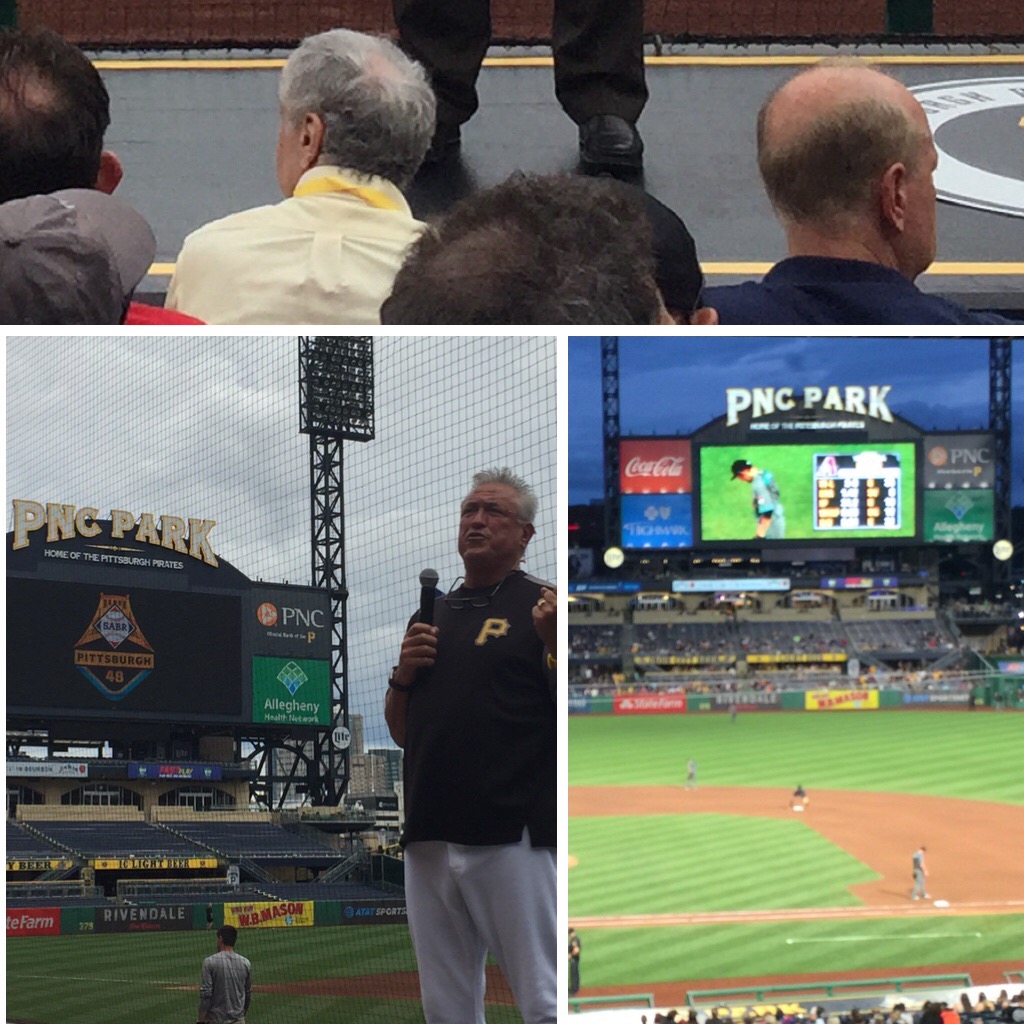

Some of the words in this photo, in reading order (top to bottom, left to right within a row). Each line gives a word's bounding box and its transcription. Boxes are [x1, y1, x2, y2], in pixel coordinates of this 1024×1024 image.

[726, 386, 795, 427] PNC
[803, 385, 894, 424] PARK
[951, 448, 989, 464] PNC
[12, 499, 103, 551] PNC
[110, 509, 219, 568] PARK
[44, 549, 68, 558] HOME
[70, 551, 81, 559] OF
[83, 552, 99, 562] THE
[101, 554, 151, 567] PITTSBURGH
[152, 559, 184, 569] PIRATES
[281, 607, 324, 627] PNC
[102, 622, 128, 632] SABR
[475, 618, 511, 646] P
[77, 653, 152, 666] PITTSBURGH
[105, 669, 125, 683] 48
[264, 698, 320, 714] Allegheny
[264, 713, 287, 722] Health
[289, 714, 319, 723] Network
[334, 731, 349, 743] Lite
[19, 861, 51, 870] BEER
[132, 859, 163, 868] LIGHT
[167, 859, 190, 868] BEER
[104, 907, 185, 922] RIVENDALE
[356, 907, 375, 916] AT&T
